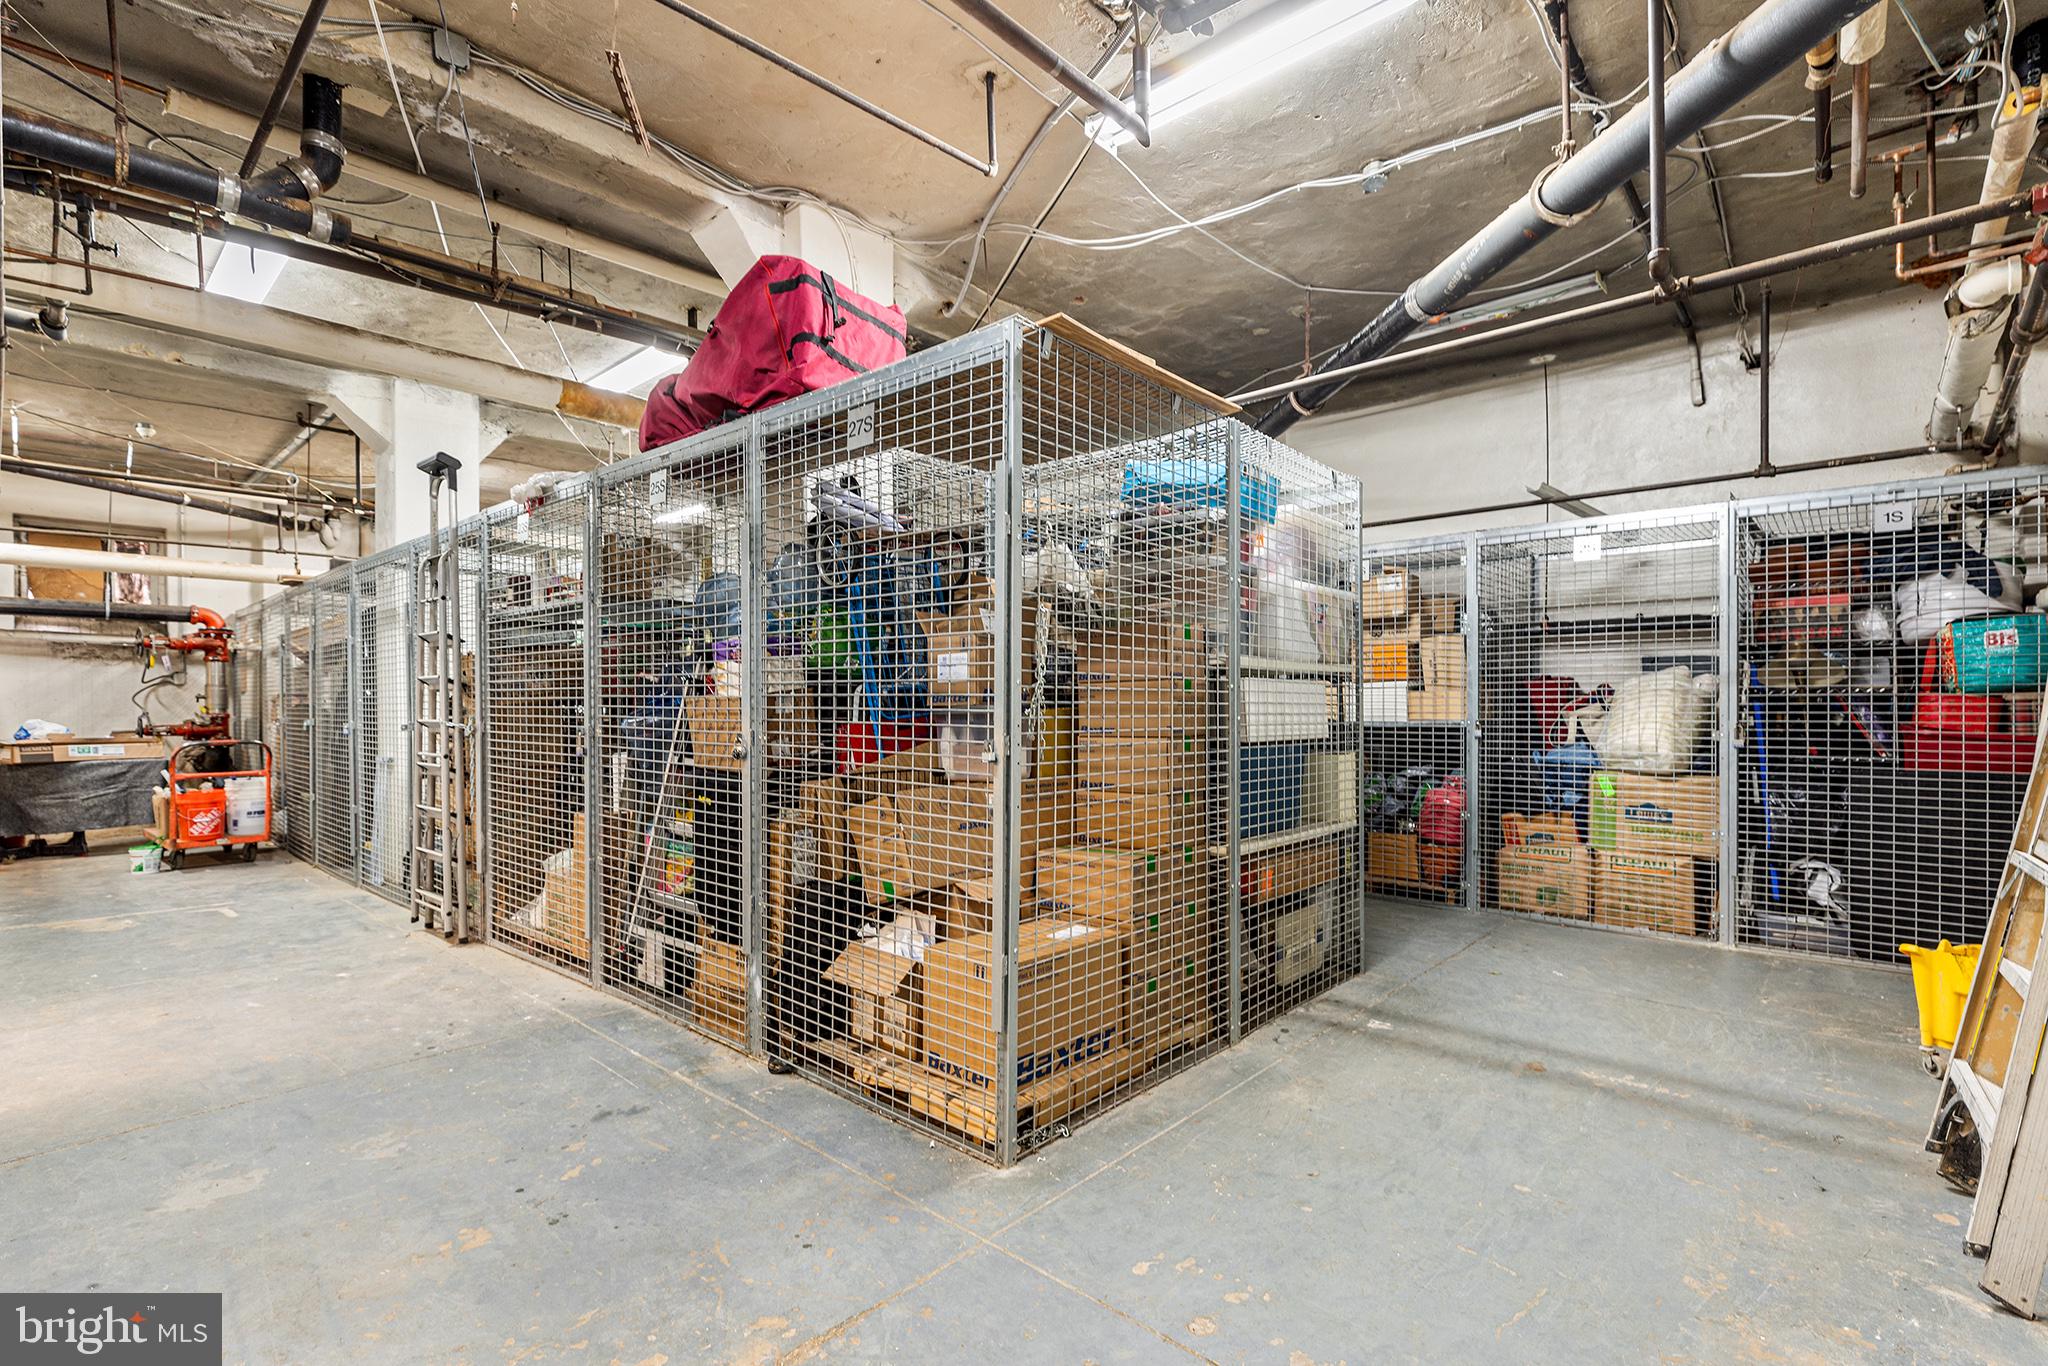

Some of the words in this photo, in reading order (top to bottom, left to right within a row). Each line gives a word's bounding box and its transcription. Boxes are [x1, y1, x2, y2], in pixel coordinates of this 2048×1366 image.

[849, 416, 873, 438] 27S
[650, 479, 666, 496] 25S
[1883, 511, 1904, 523] 1S
[1017, 1027, 1116, 1088] Baxter
[928, 1051, 993, 1089] Baxter
